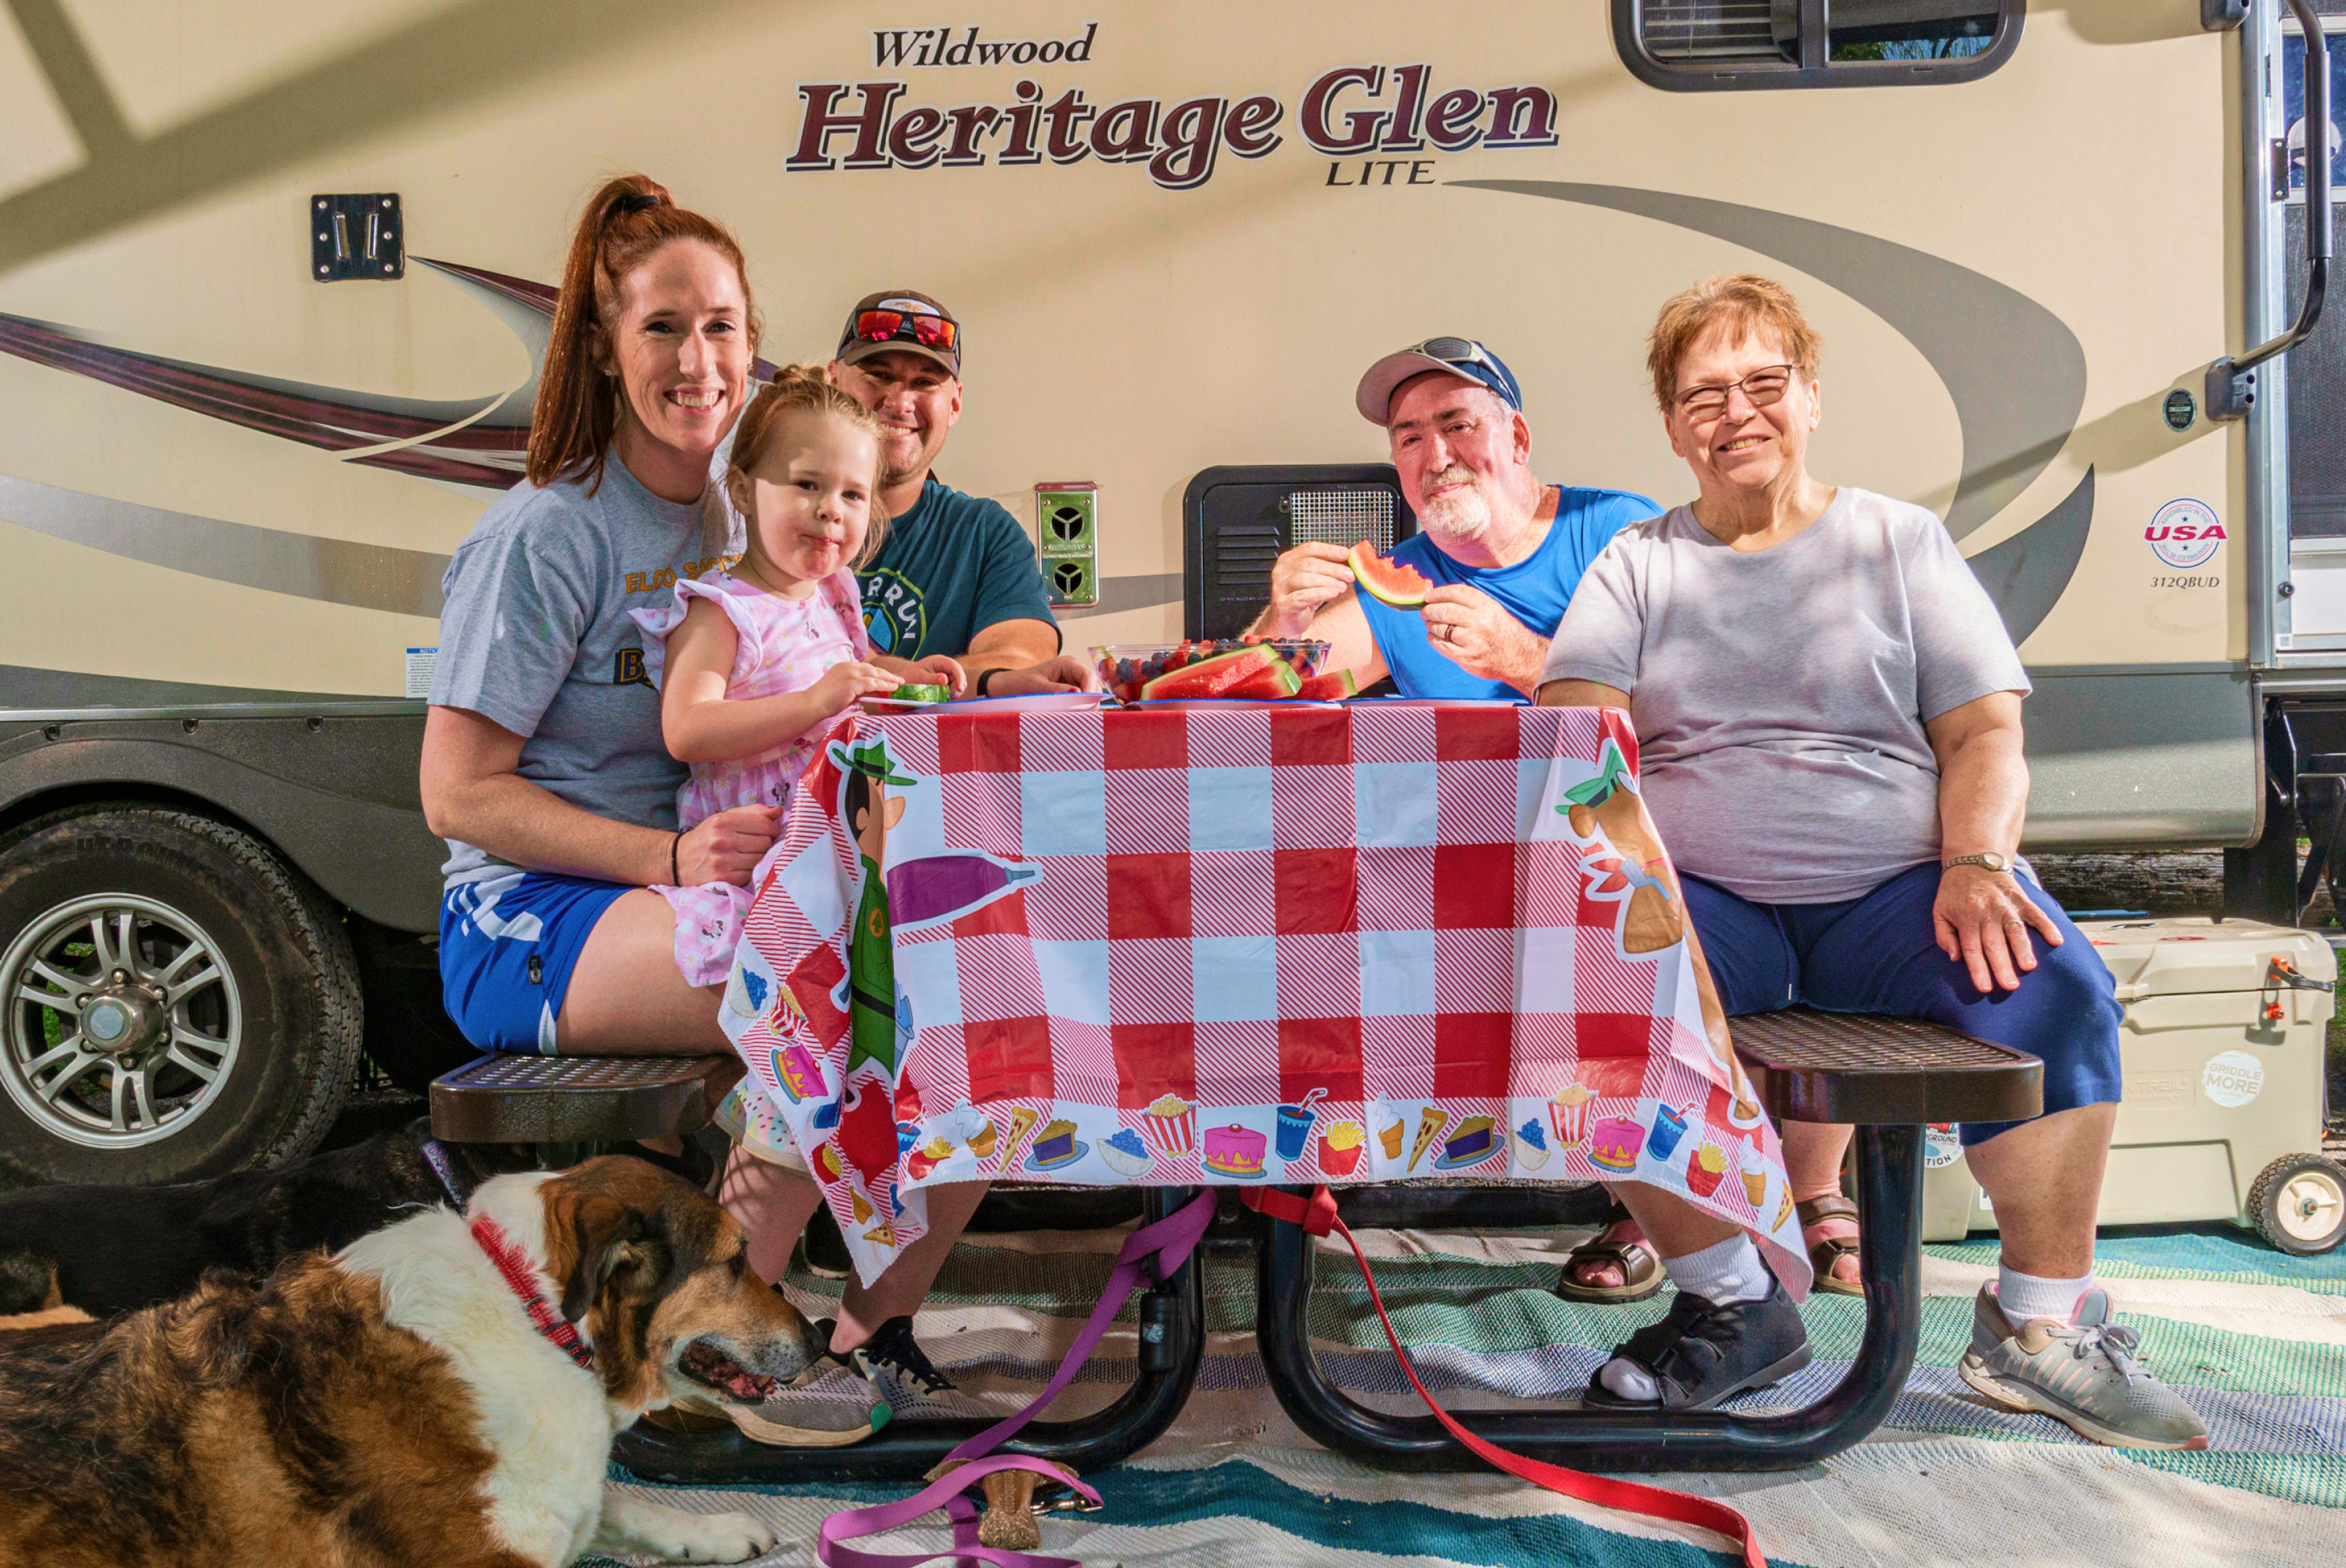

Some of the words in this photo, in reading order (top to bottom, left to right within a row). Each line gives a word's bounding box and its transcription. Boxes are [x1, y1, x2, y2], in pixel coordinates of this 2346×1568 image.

[872, 22, 1098, 67] Wildwood
[785, 79, 1284, 191] Heritage
[1301, 63, 1560, 156] Glen
[1324, 160, 1436, 186] LITE
[2161, 506, 2193, 525] ASSEMBLED
[2199, 513, 2210, 524] THE
[2144, 525, 2227, 541] USA
[625, 567, 677, 595] ELCO
[2150, 576, 2220, 589] 312QBUD
[2209, 1062, 2262, 1081] GRIDDLE
[2205, 1073, 2260, 1095] MORE
[1926, 1155, 1952, 1166] TION
